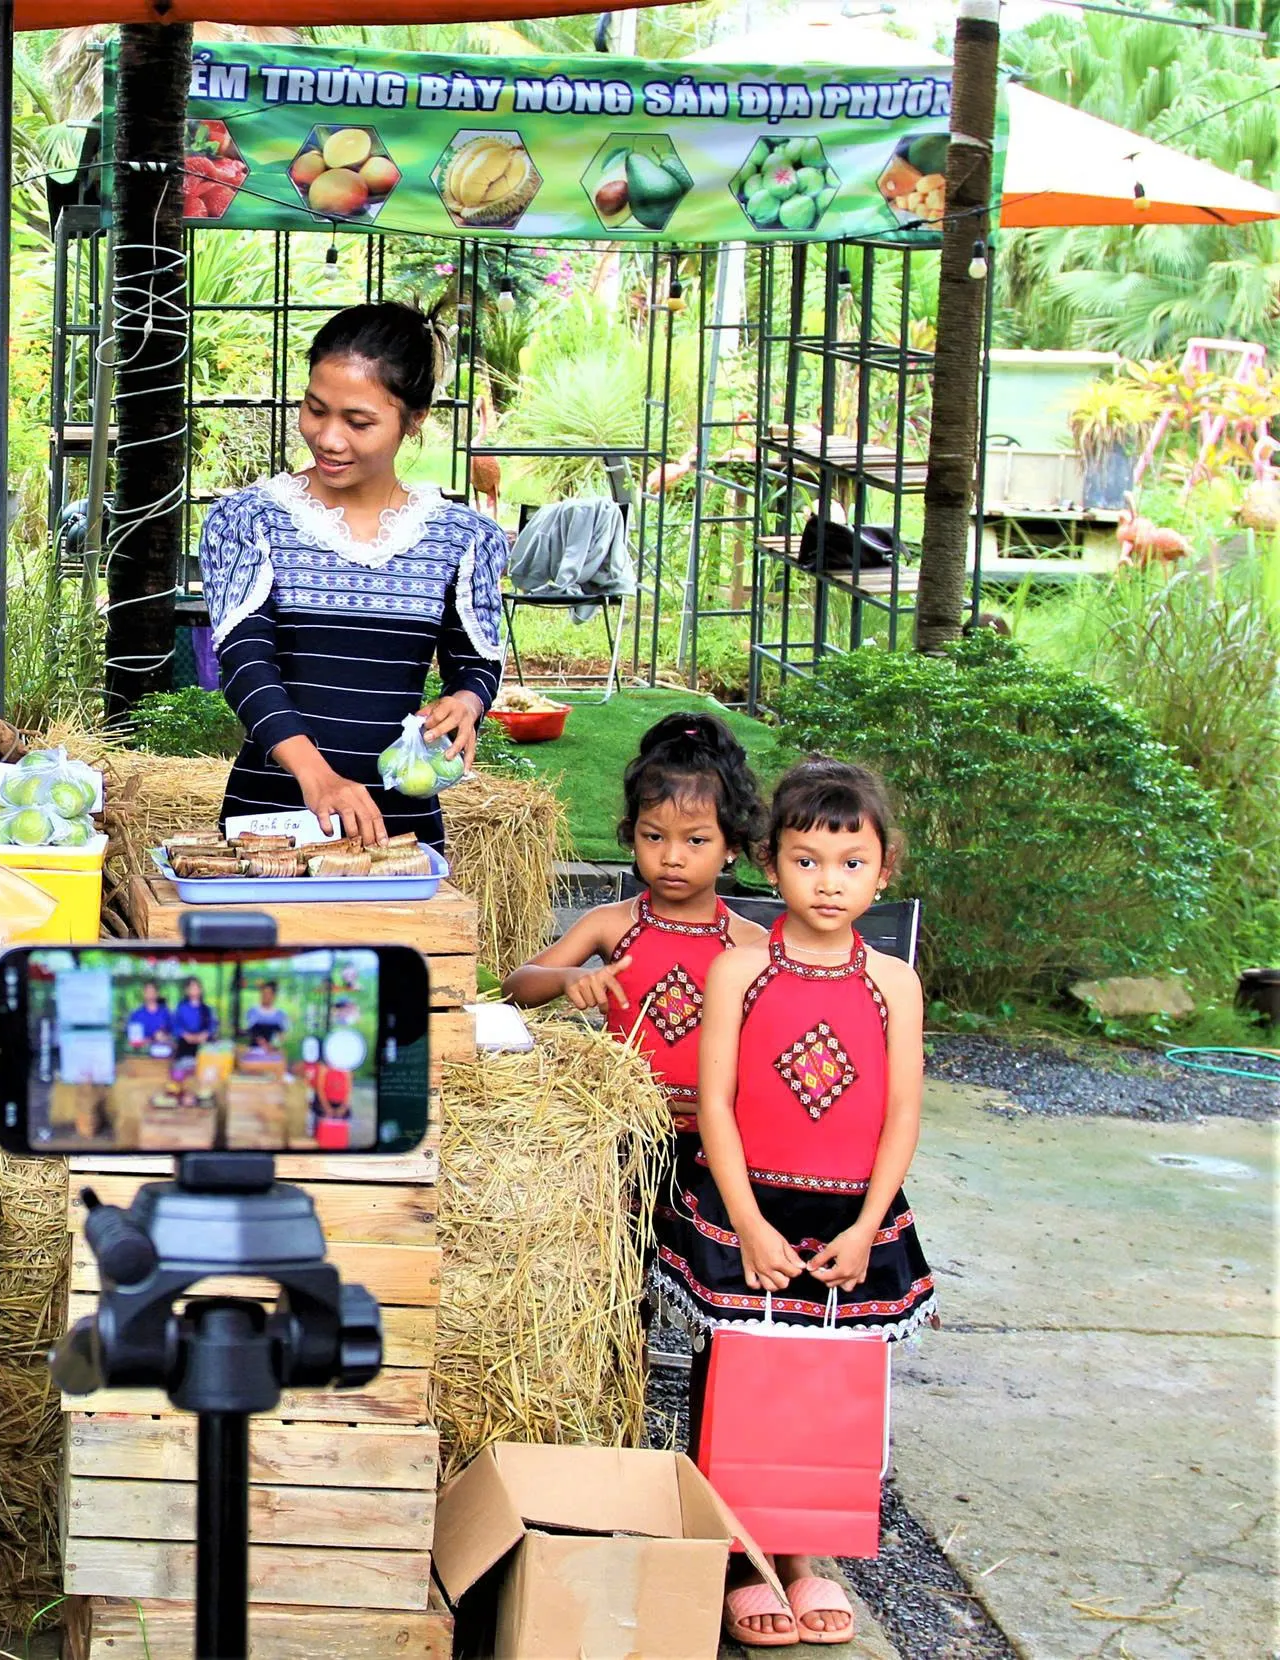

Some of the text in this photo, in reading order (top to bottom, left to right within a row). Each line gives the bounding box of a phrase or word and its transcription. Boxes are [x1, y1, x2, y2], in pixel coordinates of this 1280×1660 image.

[188, 51, 952, 123] ỂM TRƯNG BÀY NÔNG SẢN ĐỊA PHƯƠN
